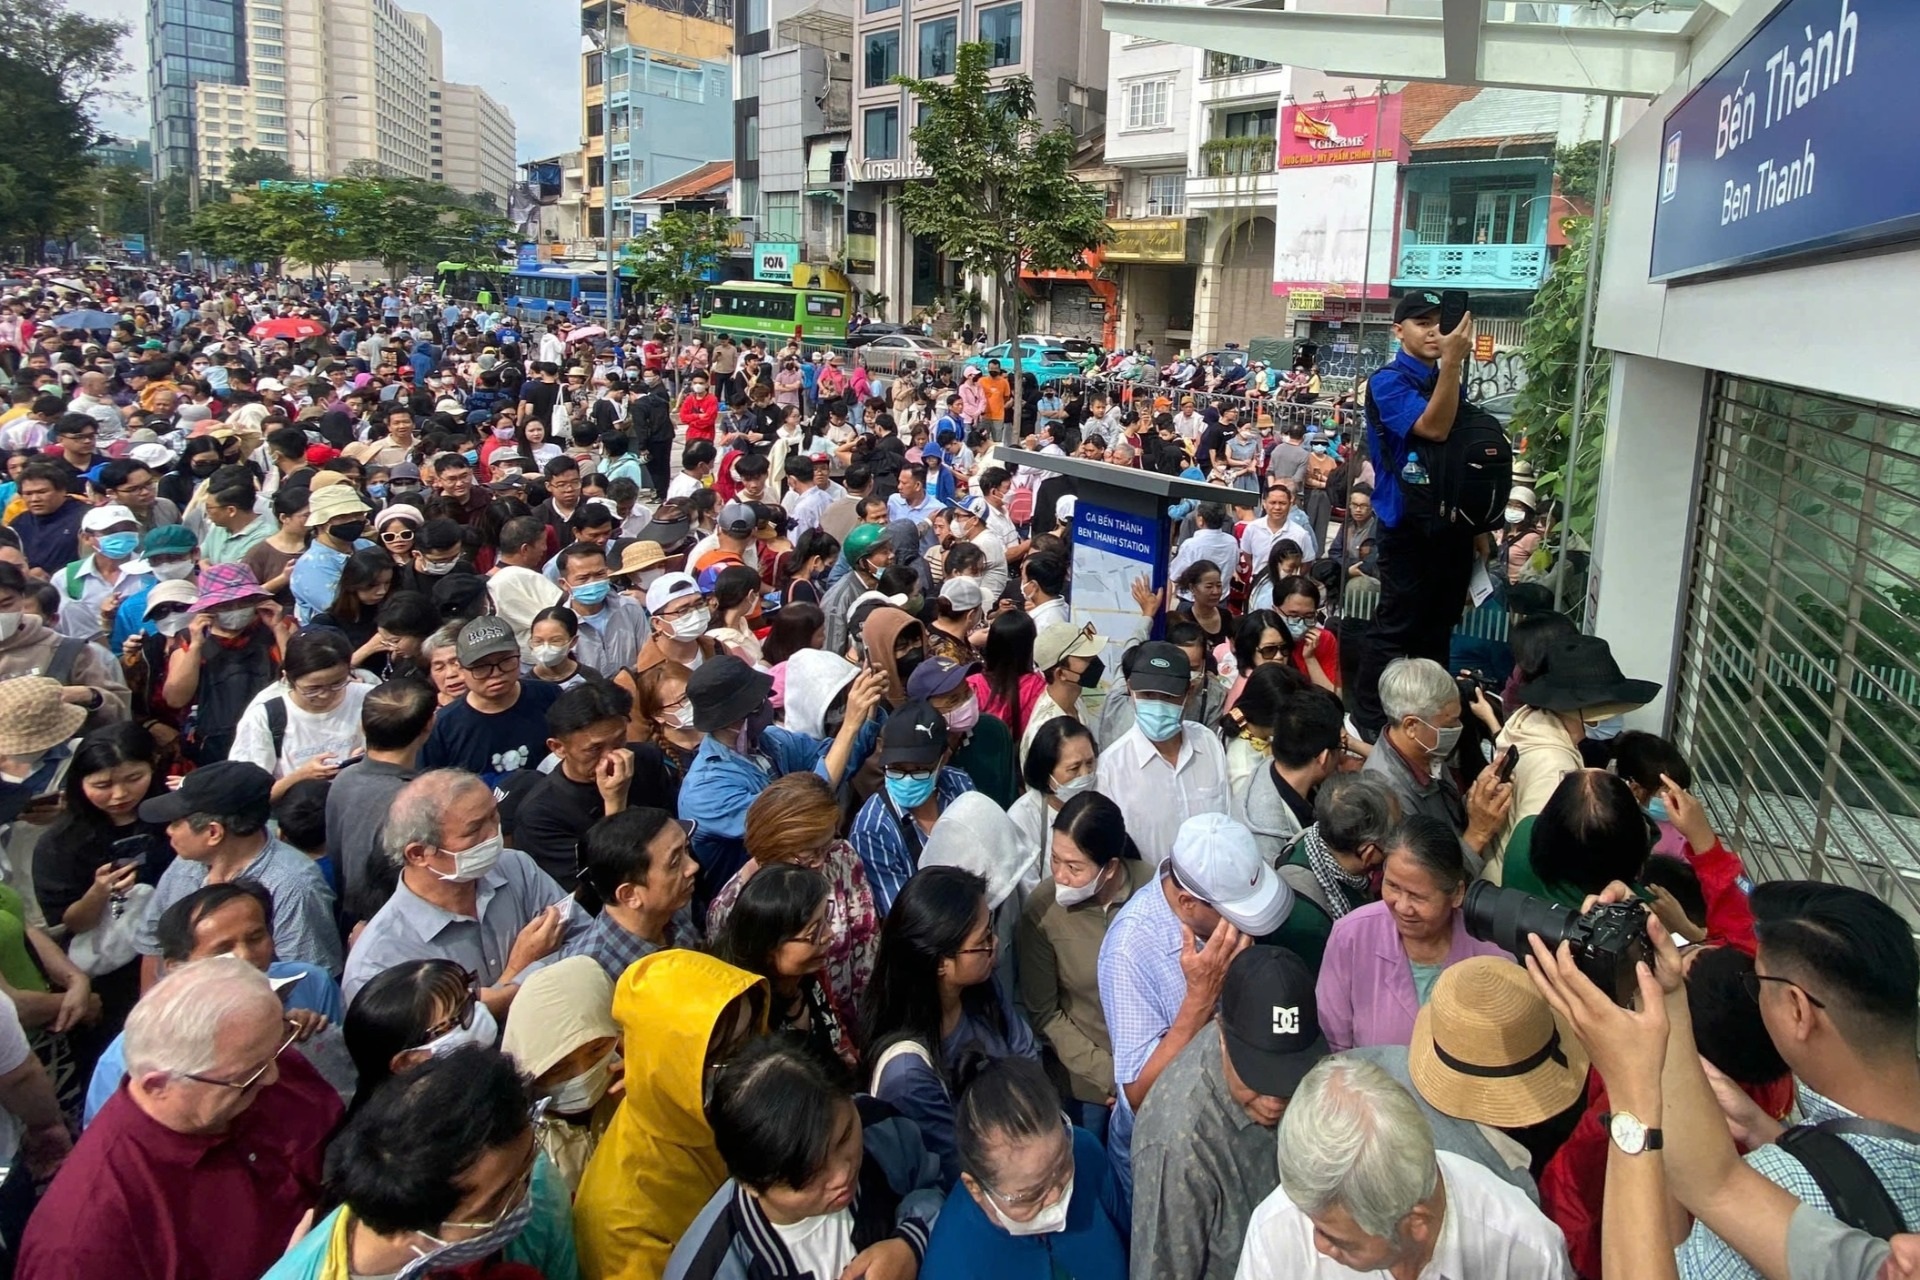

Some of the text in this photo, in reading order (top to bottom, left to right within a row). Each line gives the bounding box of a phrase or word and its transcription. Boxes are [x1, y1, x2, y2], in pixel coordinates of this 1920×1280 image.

[1715, 0, 1859, 160] Bến Thành
[1721, 138, 1816, 227] Ben Thanh
[1085, 512, 1143, 536] GA BẾN THÀNH
[1077, 526, 1151, 555] BEN THANH STATION
[467, 626, 505, 642] BOSS
